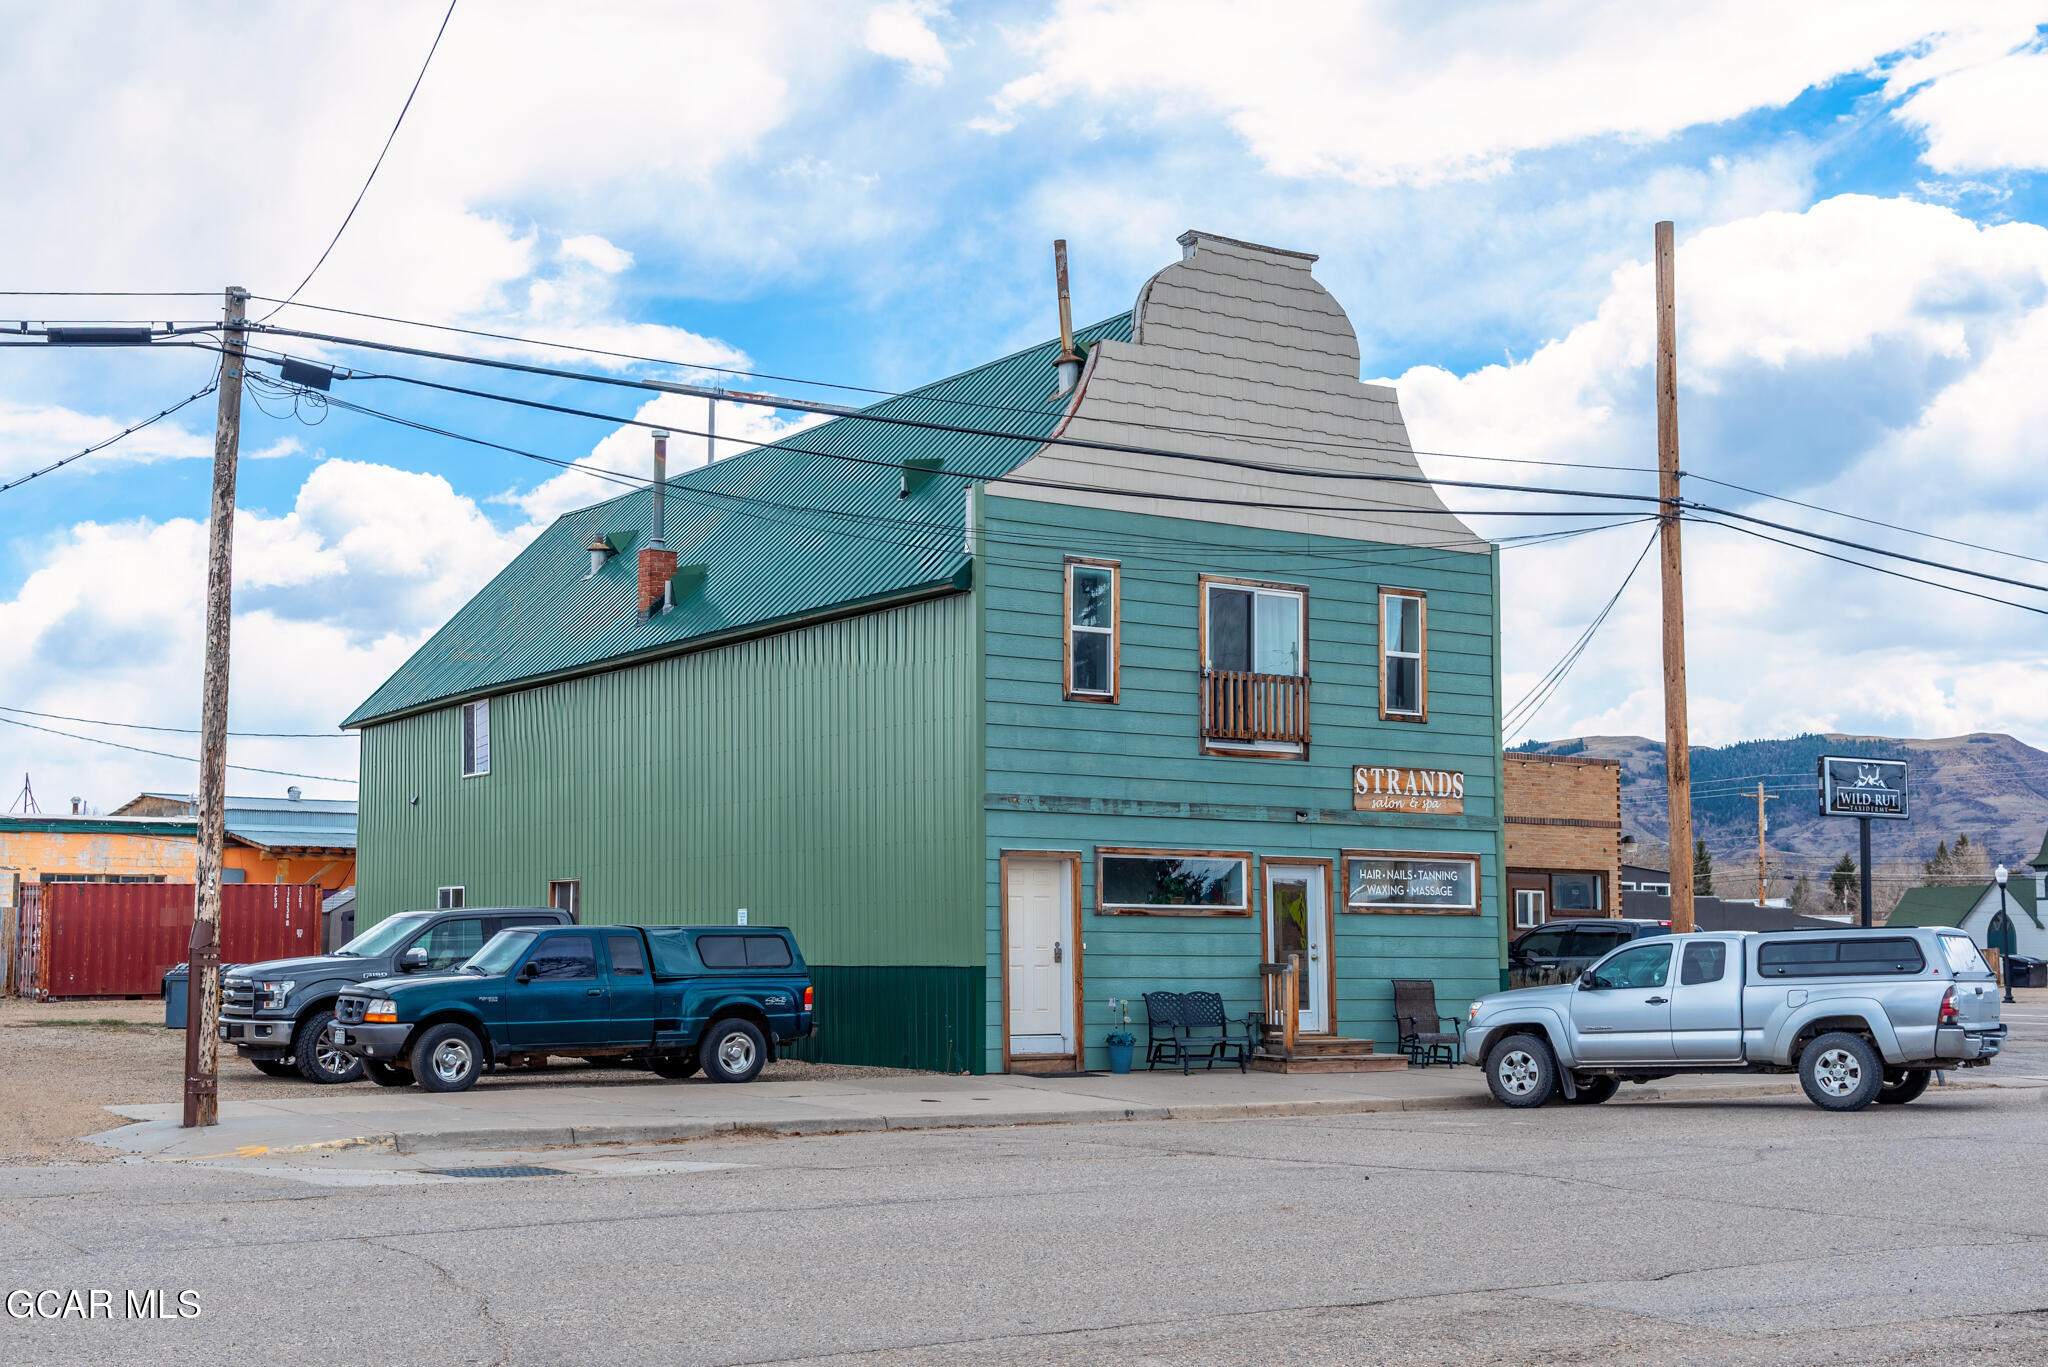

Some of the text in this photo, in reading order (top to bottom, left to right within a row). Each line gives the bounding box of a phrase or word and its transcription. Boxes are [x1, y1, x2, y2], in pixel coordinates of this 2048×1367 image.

[1356, 768, 1464, 799] STRANDS
[1372, 796, 1404, 809] salon
[1422, 799, 1441, 813] spa
[1840, 792, 1897, 806] WILD RUT
[1359, 869, 1458, 881] HAIR NAILS TANNING
[1367, 885, 1453, 896] WAXING MASSAGE
